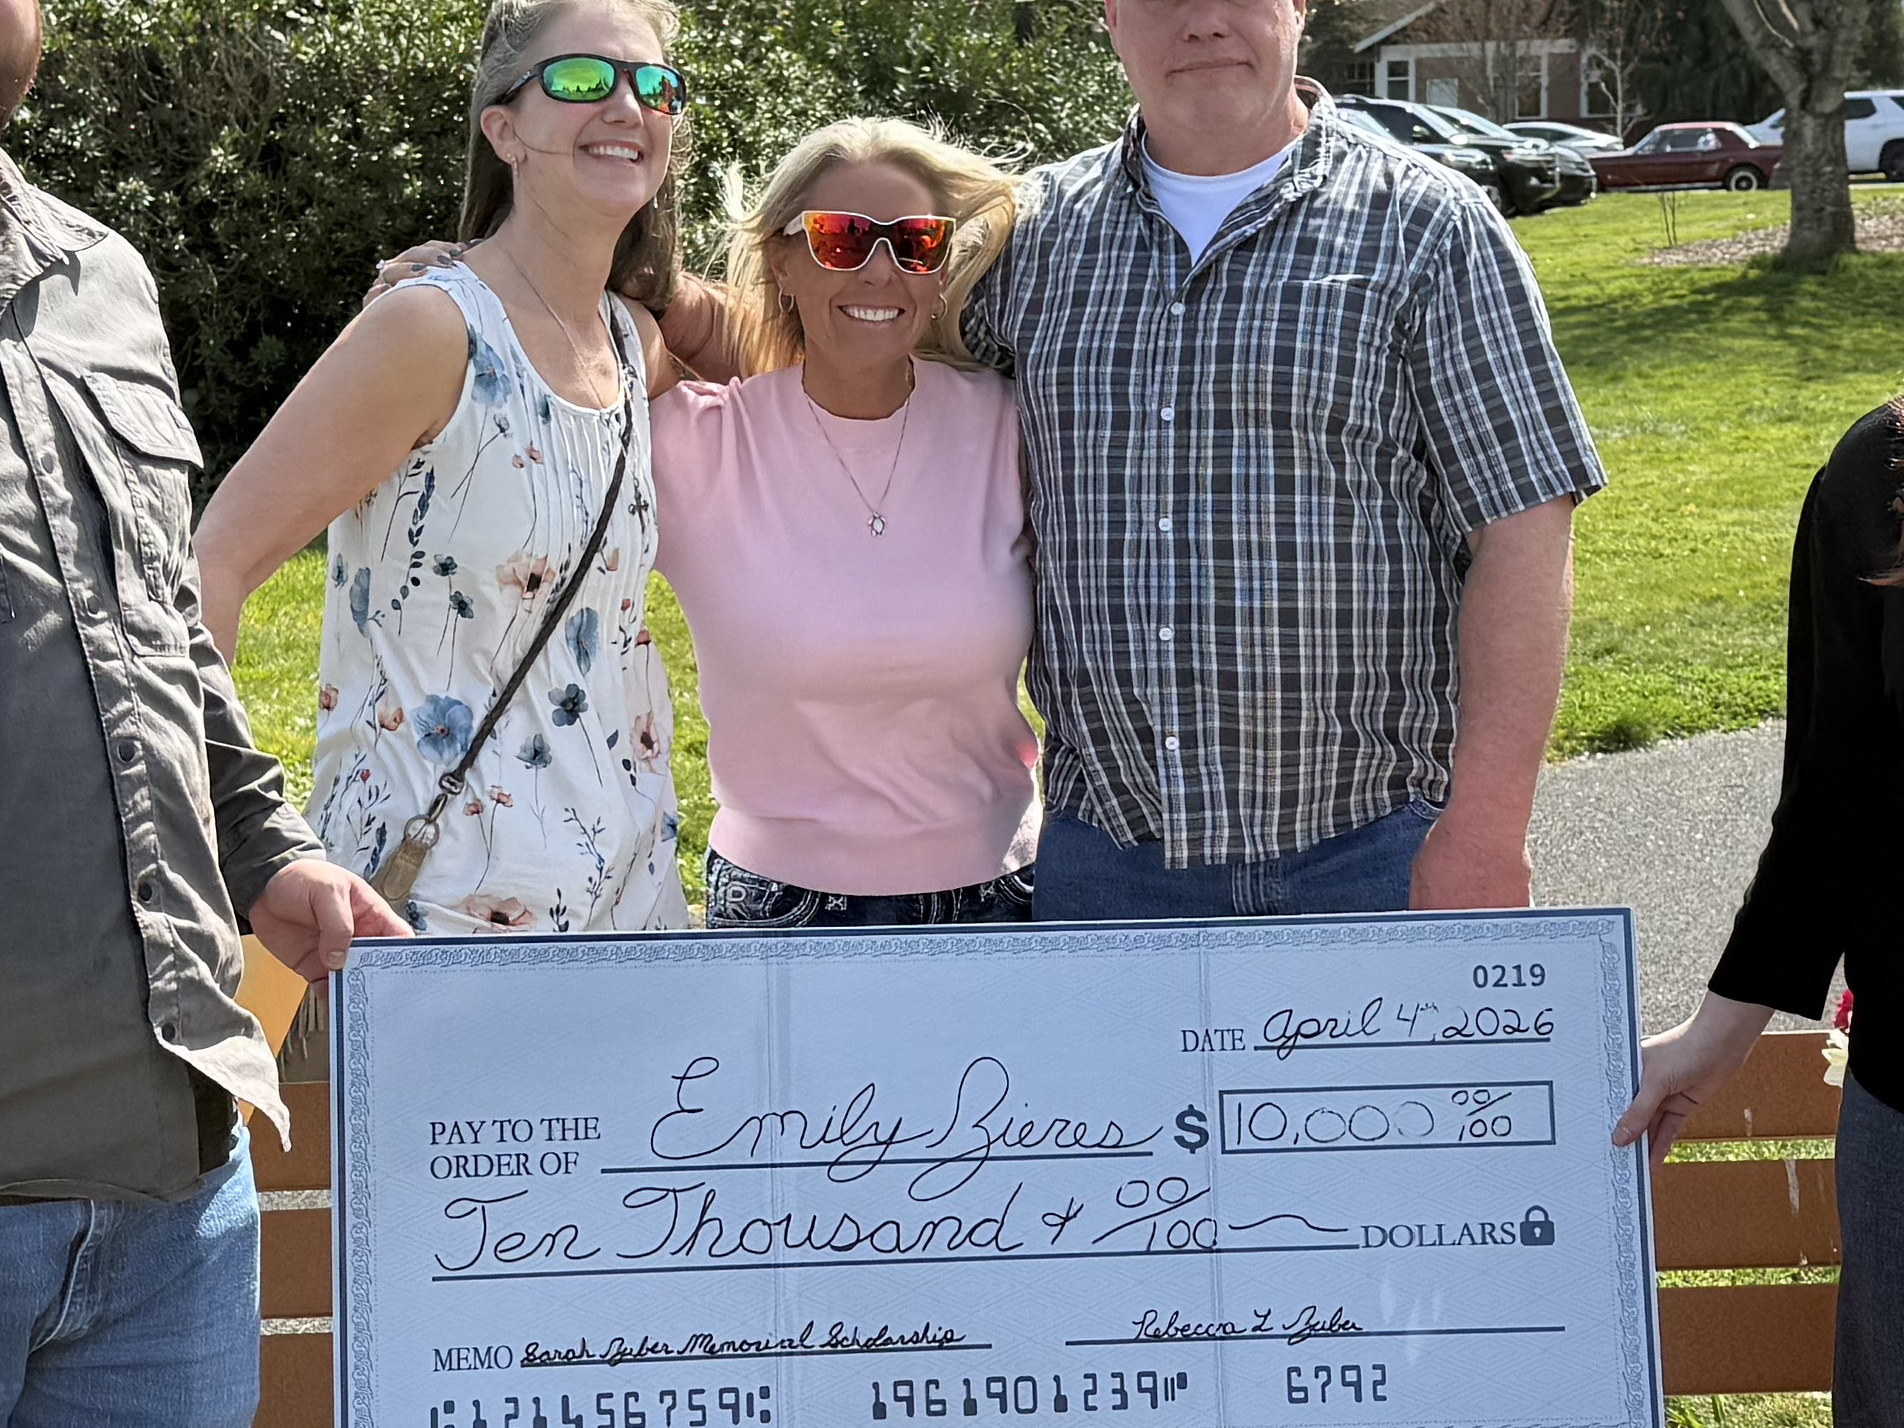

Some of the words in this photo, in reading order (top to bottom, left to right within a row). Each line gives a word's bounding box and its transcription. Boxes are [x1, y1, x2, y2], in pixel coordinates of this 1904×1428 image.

[1472, 964, 1546, 989] 0219
[1442, 1006, 1554, 1039] 2026
[1180, 1028, 1246, 1053] DATE
[429, 1120, 486, 1147] PAY
[492, 1119, 534, 1145] TO
[539, 1116, 601, 1143] THE
[650, 1056, 934, 1183] Emily
[1174, 1103, 1209, 1154] $
[1236, 1100, 1435, 1147] 10,000
[429, 1153, 536, 1181] ORDER
[539, 1151, 580, 1176] OF
[435, 1189, 600, 1271] Ten
[616, 1181, 1024, 1259] Thousand
[1359, 1221, 1518, 1250] DOLLARS
[522, 1336, 596, 1364] Sarah
[677, 1319, 815, 1356] Memorial
[819, 1320, 966, 1349] Scholarship
[432, 1345, 513, 1373] MEMO
[1286, 1363, 1388, 1405] 6792
